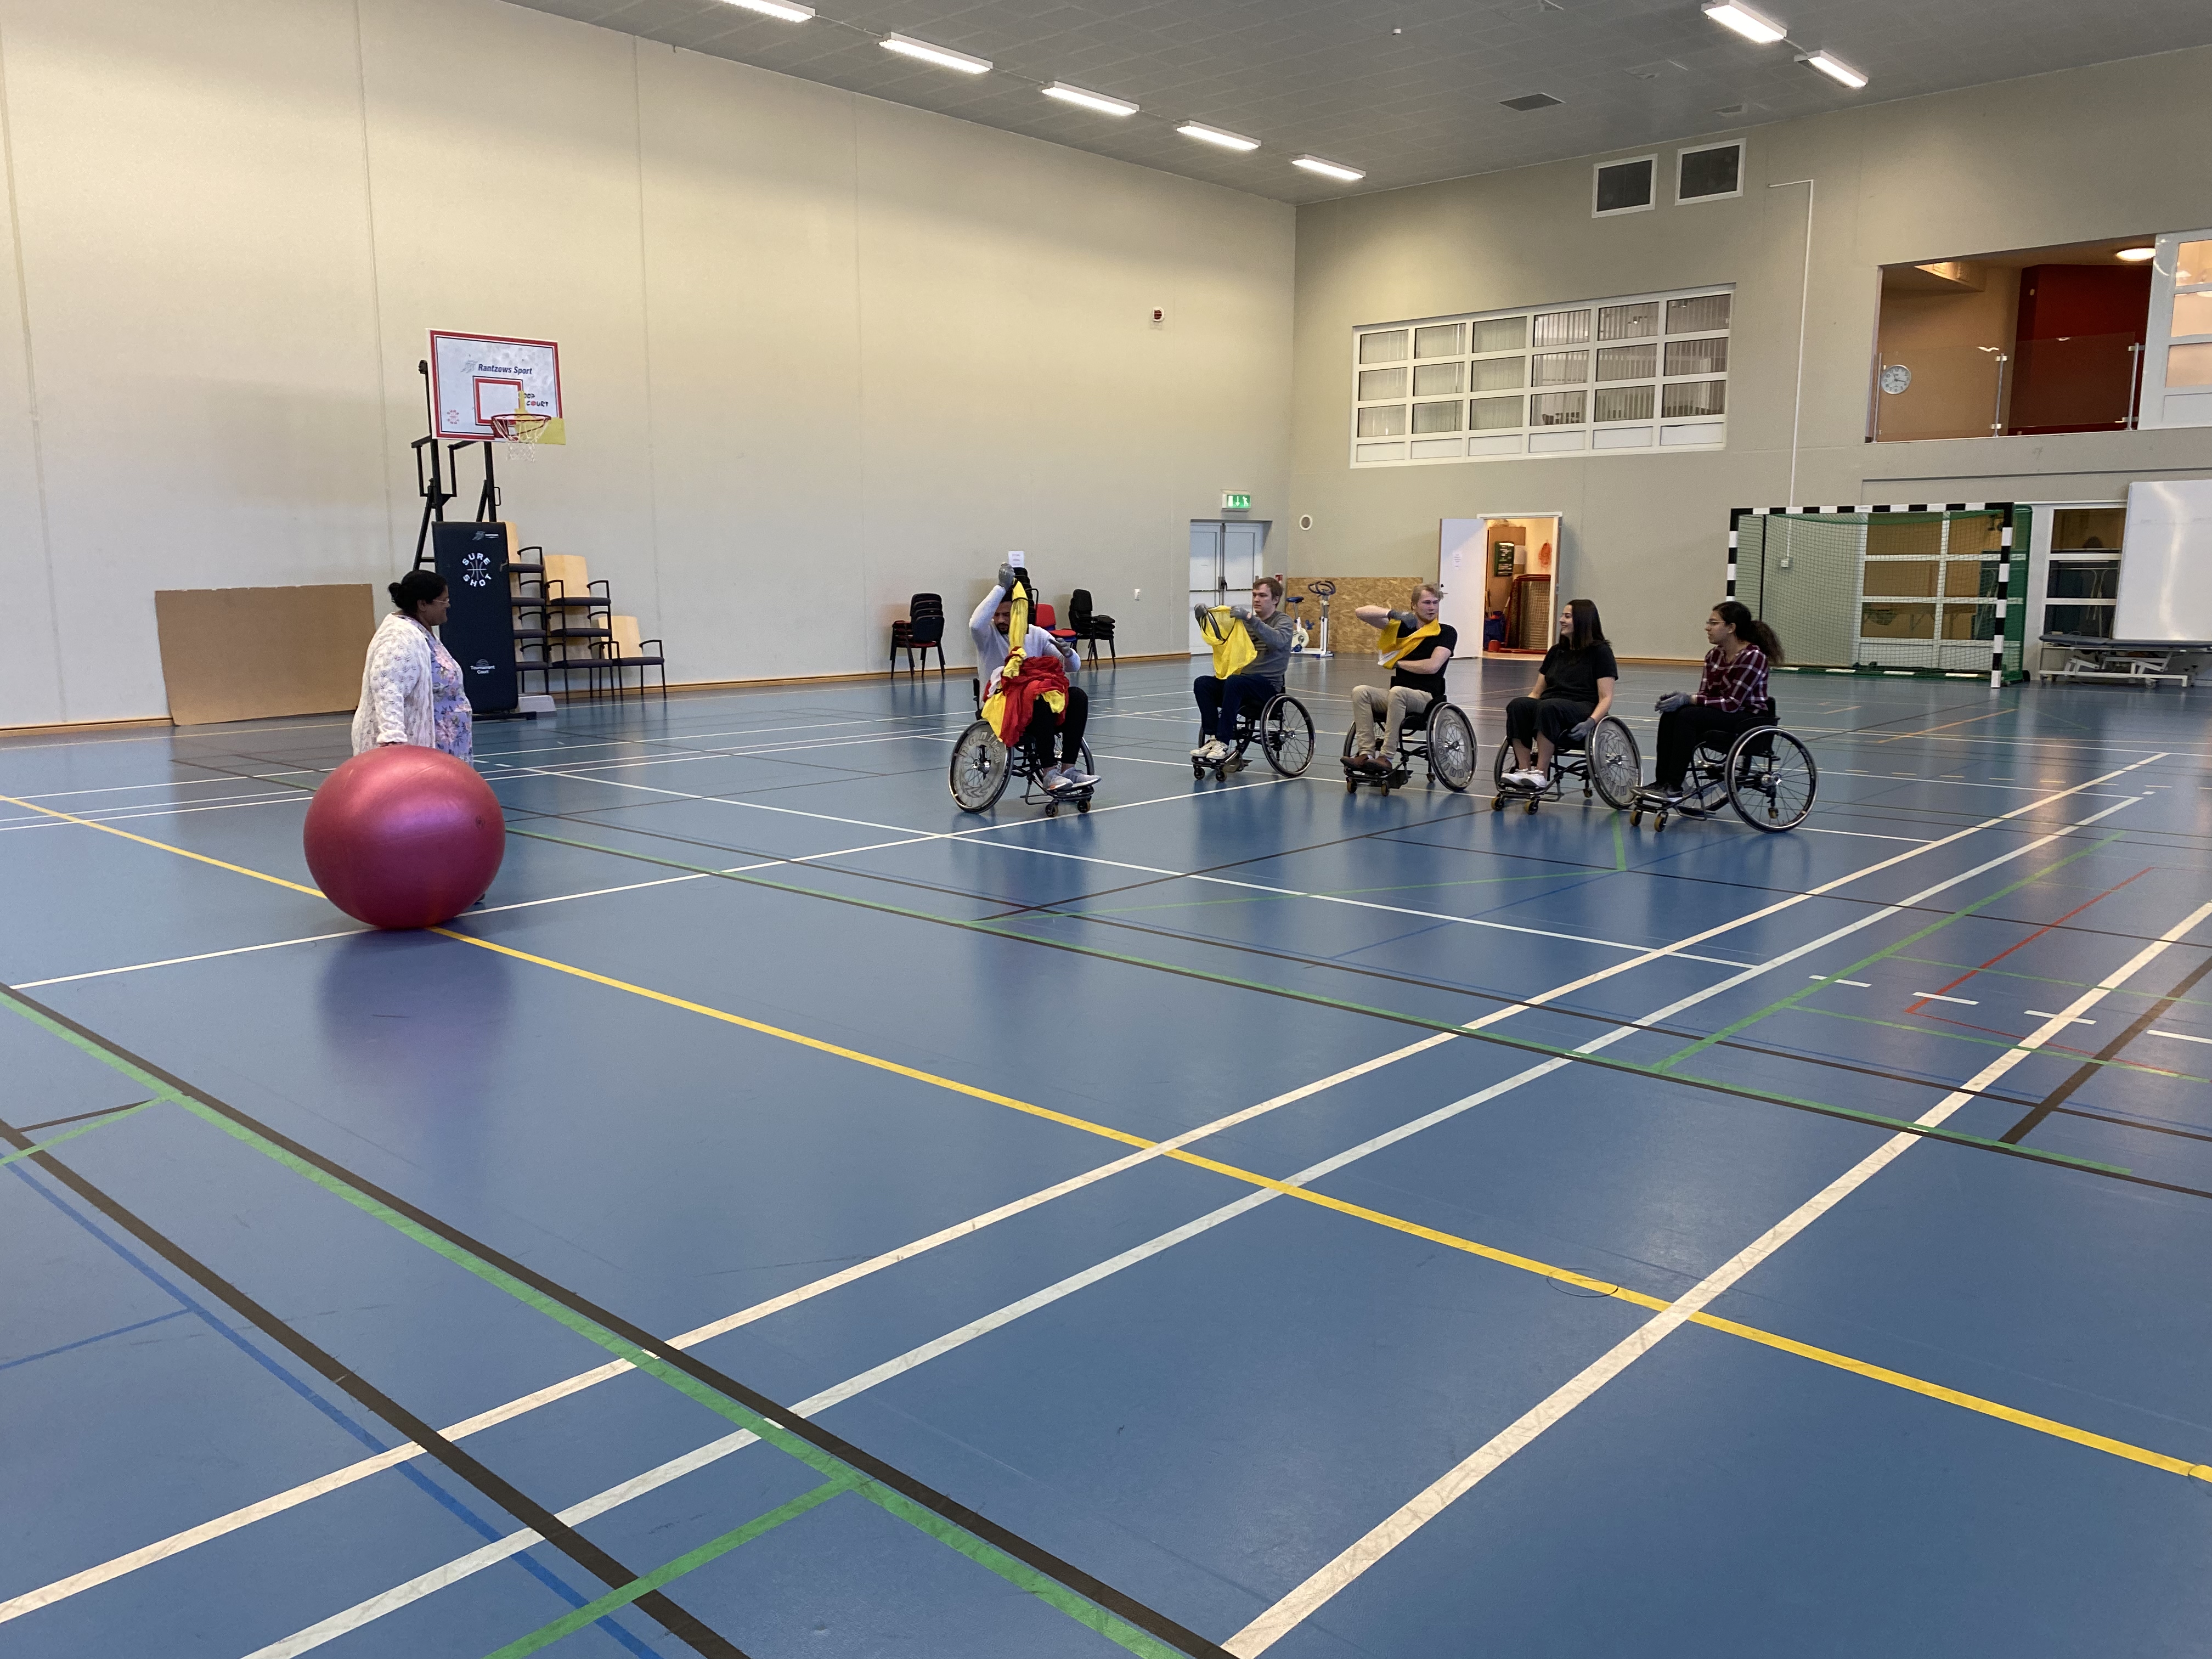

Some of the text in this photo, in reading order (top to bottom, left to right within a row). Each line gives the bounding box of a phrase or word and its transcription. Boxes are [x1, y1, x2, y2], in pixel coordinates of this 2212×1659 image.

[478, 364, 532, 375] Rantzows Sport
[462, 552, 490, 566] SURE
[462, 573, 492, 587] SHOT
